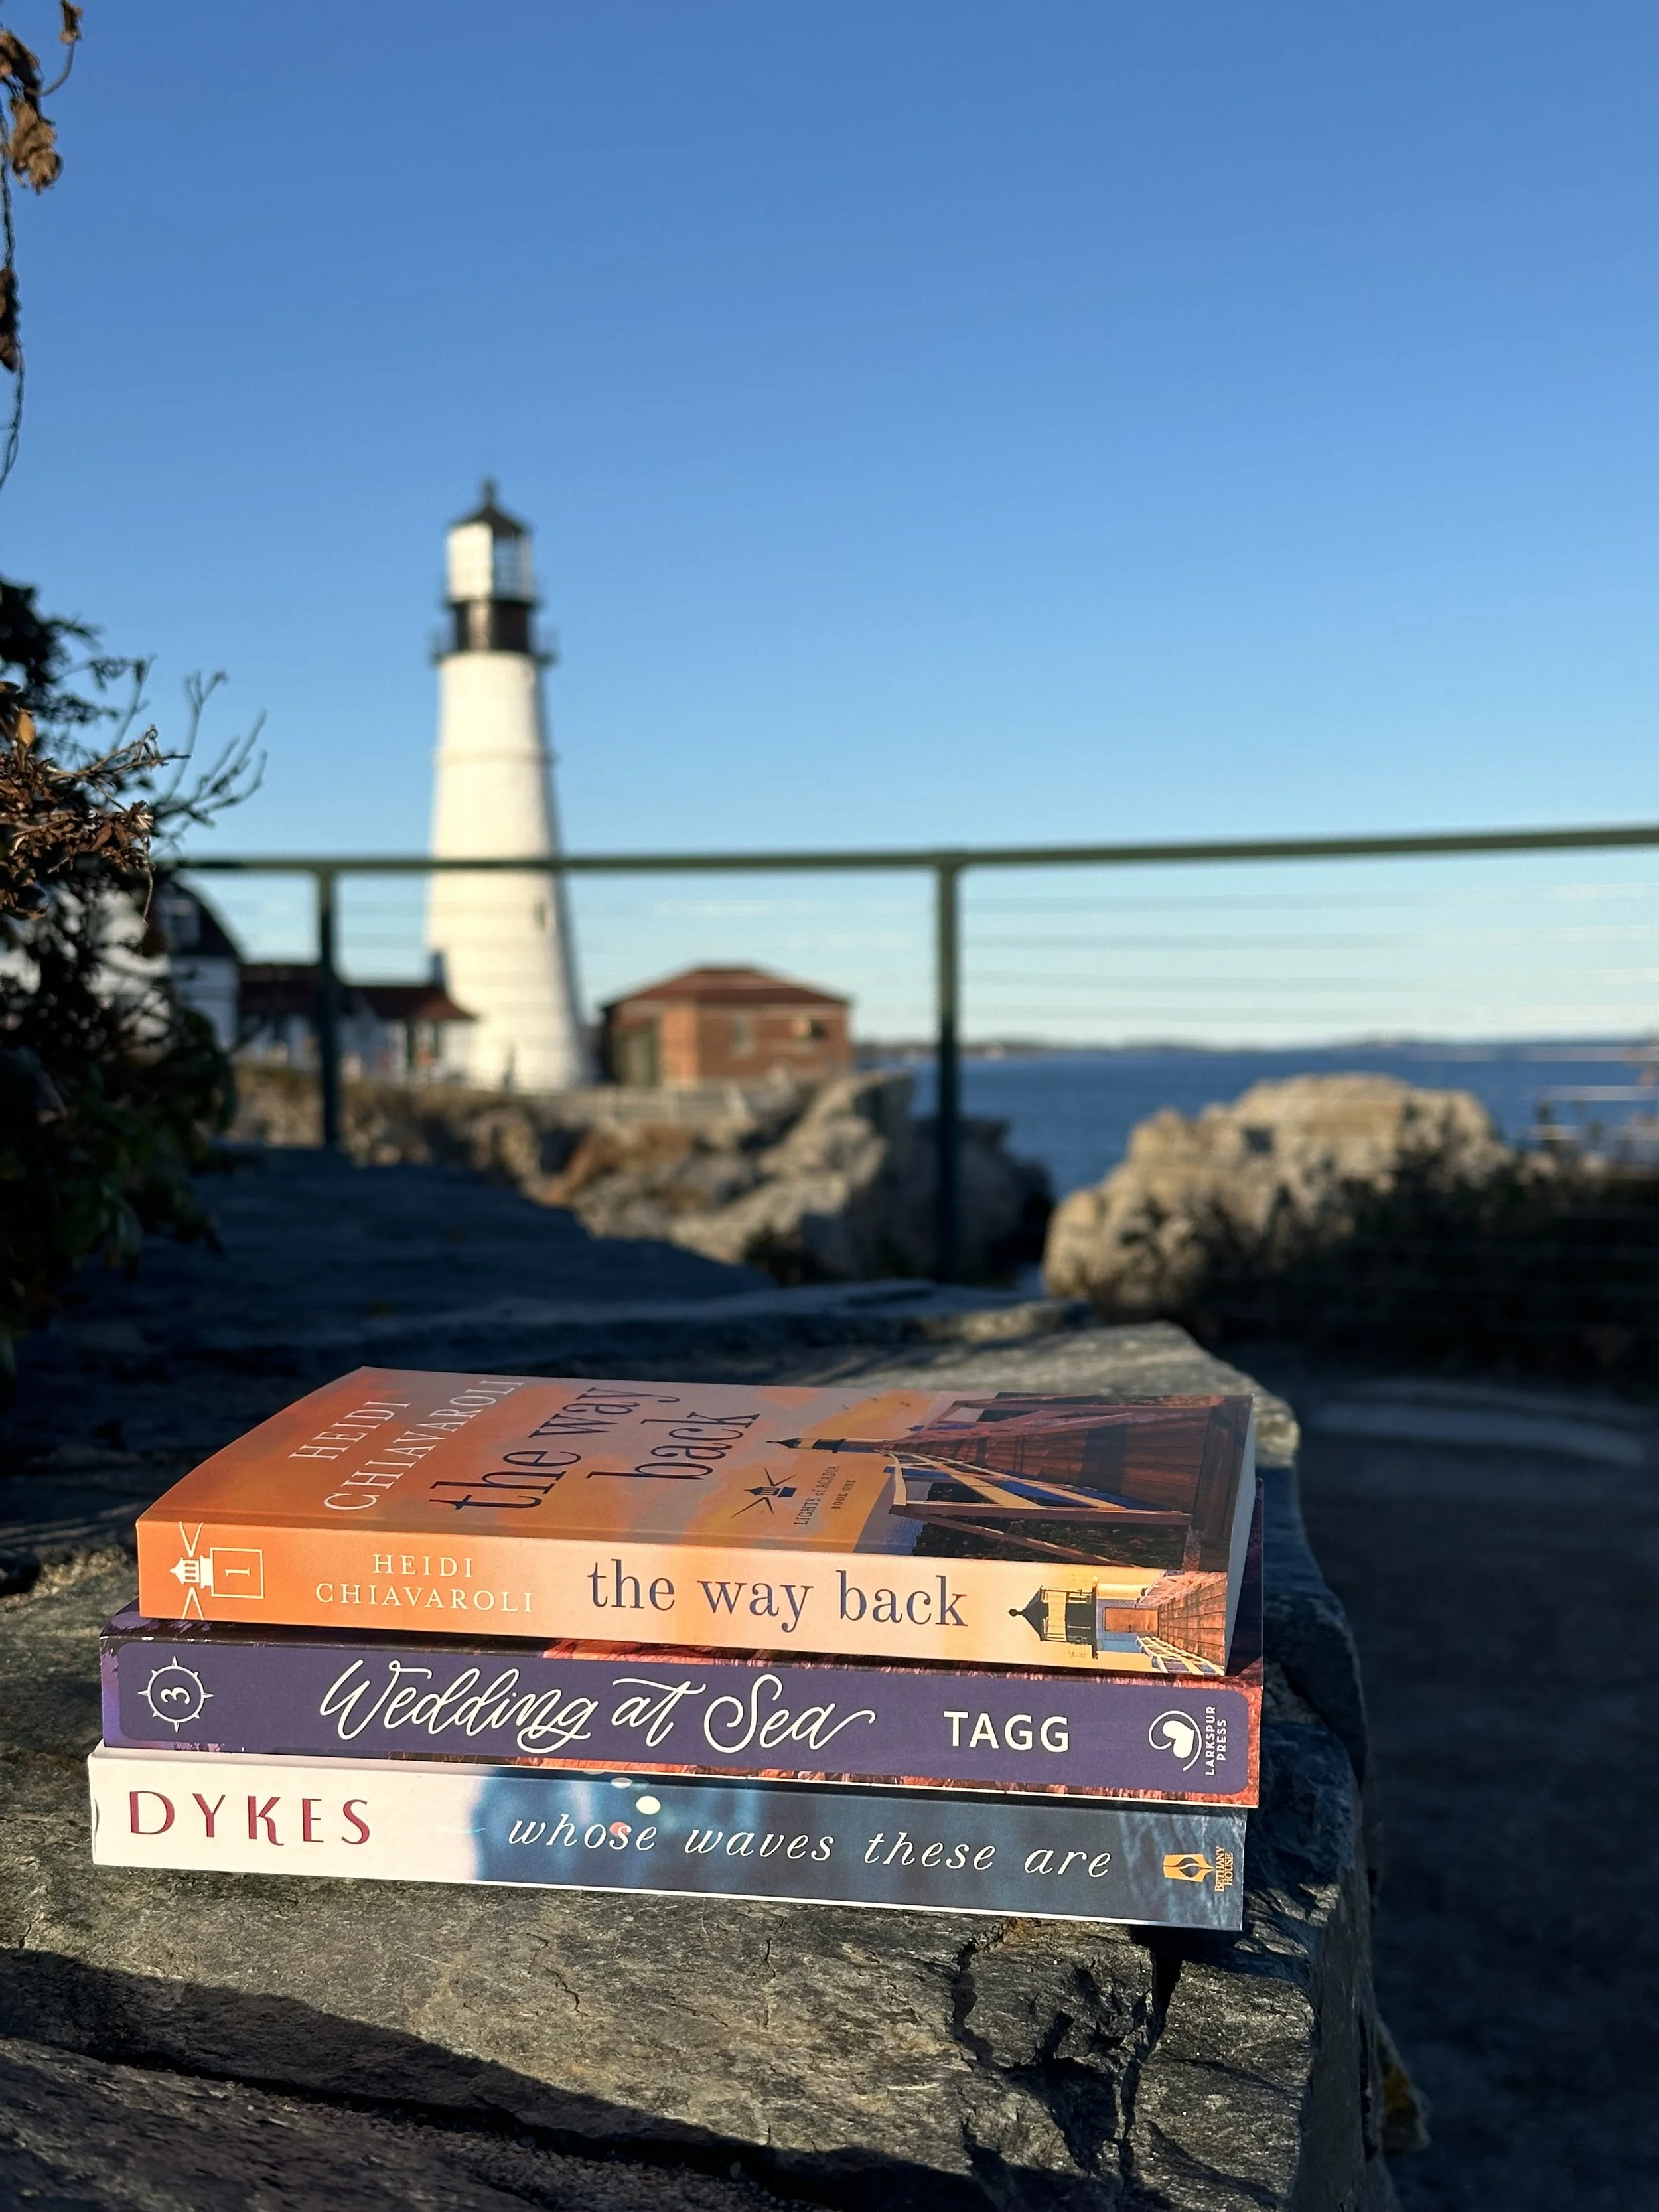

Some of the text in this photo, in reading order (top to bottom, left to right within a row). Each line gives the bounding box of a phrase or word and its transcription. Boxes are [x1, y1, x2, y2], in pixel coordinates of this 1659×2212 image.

[288, 1400, 411, 1460] HEIDI
[323, 1380, 524, 1511] CHIAVAROLI
[429, 1386, 680, 1510] the way
[586, 1411, 761, 1480] back
[794, 1497, 821, 1525] LIGHTS
[224, 1567, 251, 1577] 1
[372, 1553, 474, 1578] HEIDI
[315, 1583, 534, 1613] CHIAVAROLI
[587, 1559, 968, 1633] the way back
[161, 1686, 191, 1705] 3
[319, 1659, 876, 1754] Wedding at Sea
[944, 1710, 1069, 1753] TAGG
[1205, 1706, 1216, 1775] LARKSPUR
[1217, 1720, 1226, 1761] PRESS
[129, 1791, 370, 1846] DYKES
[508, 1814, 1112, 1878] whose waves these are
[1214, 1846, 1225, 1891] BETHANY
[1224, 1852, 1233, 1885] HOUSE
